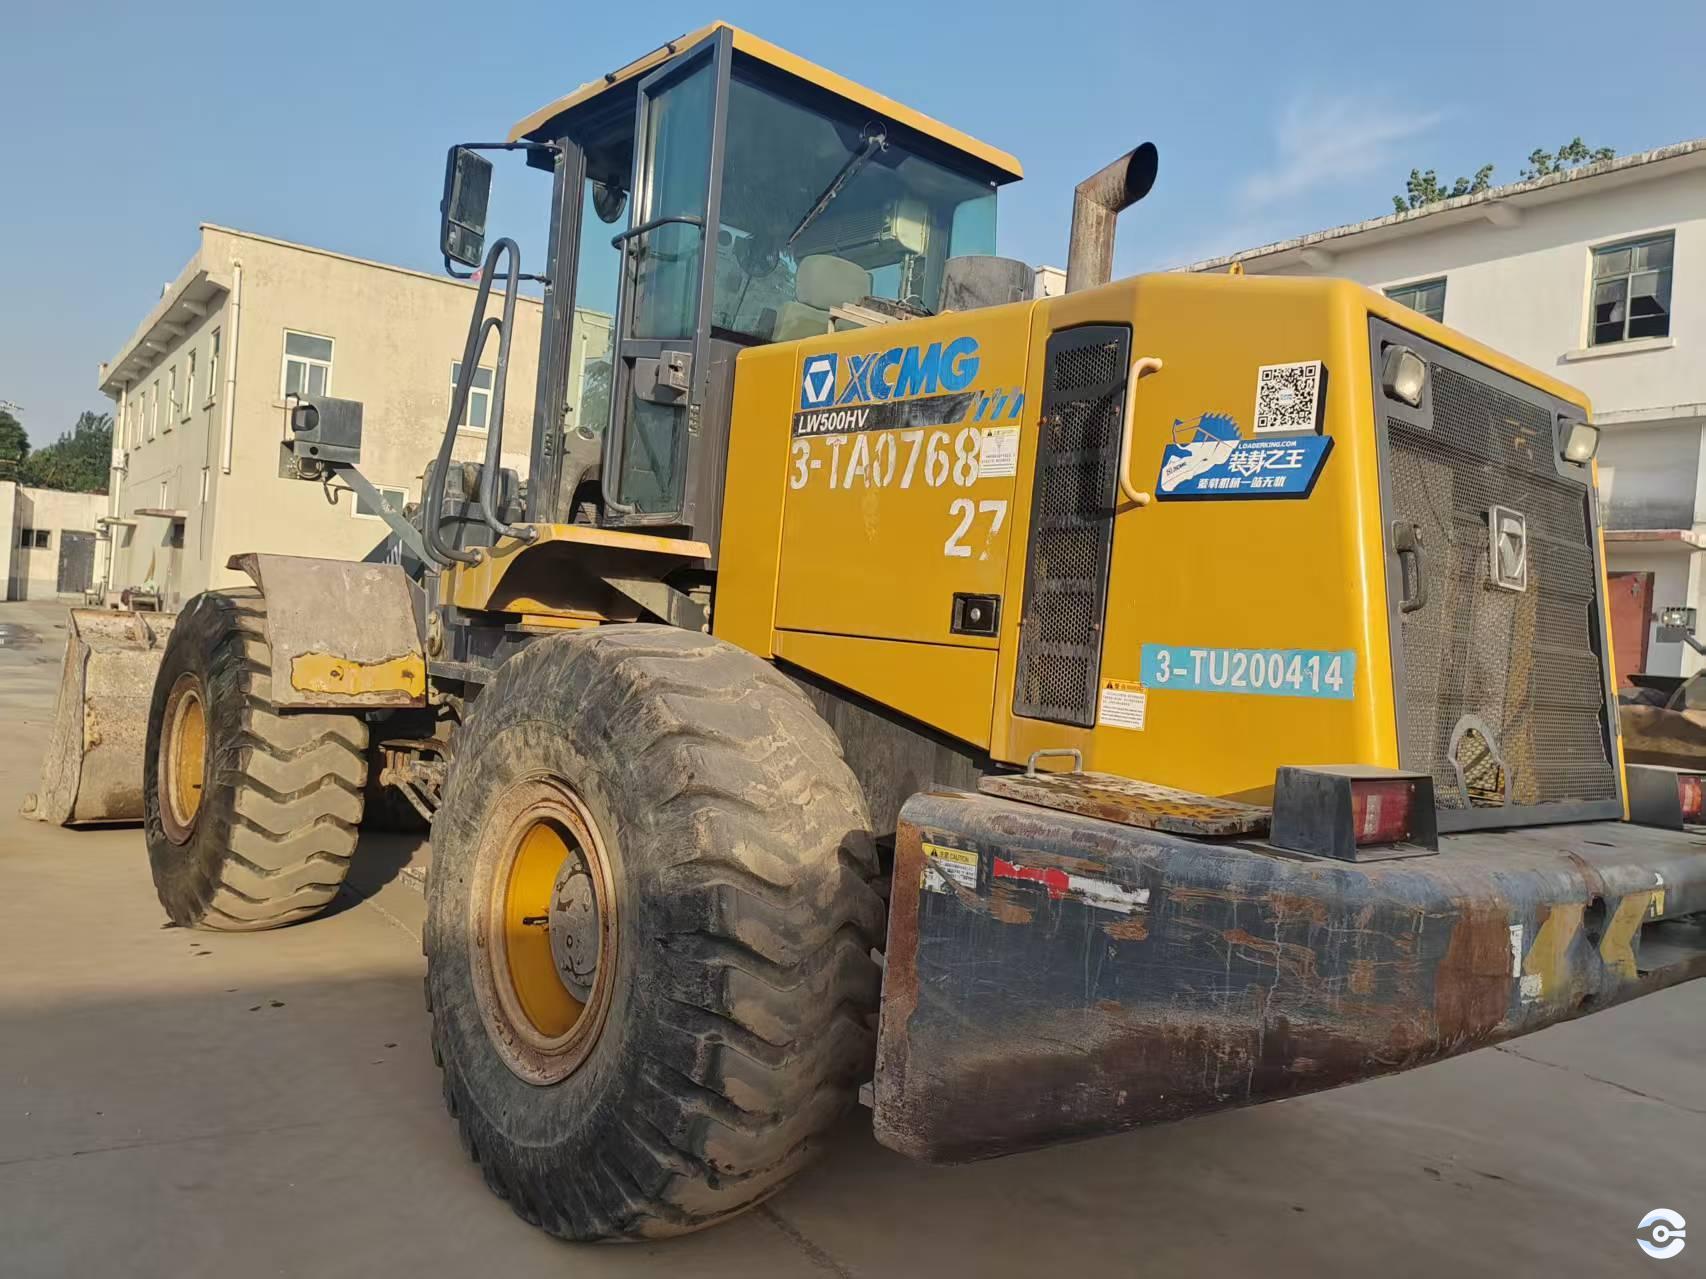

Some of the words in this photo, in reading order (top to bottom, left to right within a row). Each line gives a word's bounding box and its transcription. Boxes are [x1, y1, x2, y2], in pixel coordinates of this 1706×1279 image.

[834, 336, 980, 405] XCMG
[798, 409, 869, 433] LW500HV
[790, 427, 981, 489] 3-TA0768
[944, 498, 1008, 561] 27
[1155, 650, 1343, 692] 3-TU200414
